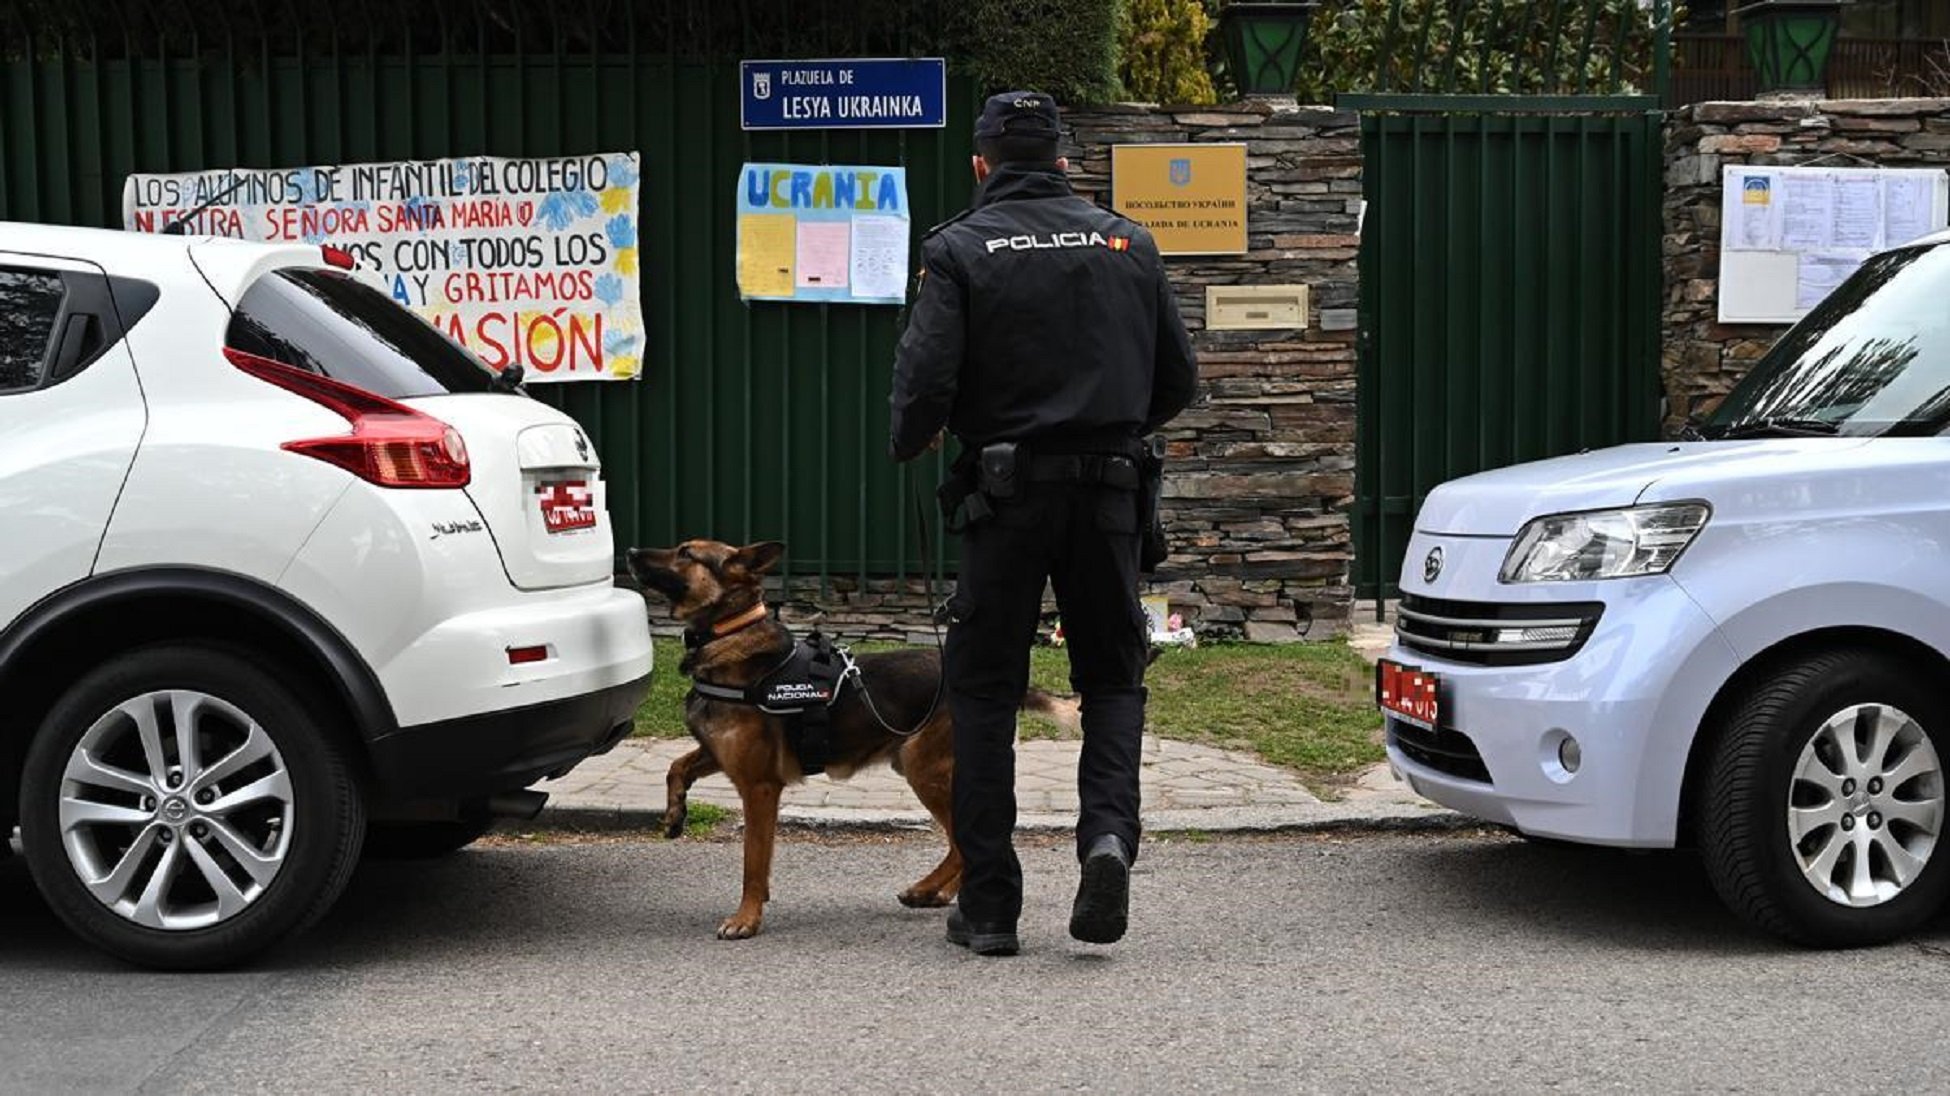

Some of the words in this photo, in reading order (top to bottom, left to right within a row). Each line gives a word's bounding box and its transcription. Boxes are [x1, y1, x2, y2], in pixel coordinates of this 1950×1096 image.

[781, 70, 834, 85] PLAZUELA
[839, 70, 854, 84] DE
[782, 96, 831, 119] LESYA
[838, 95, 923, 118] UKRAINKA
[134, 175, 180, 207] LOS
[194, 170, 303, 206] ALUMNOS
[314, 168, 342, 202] DE
[352, 162, 464, 201] INFANTIL
[503, 156, 609, 195] COLEGIO
[747, 169, 898, 210] UCRANIA
[265, 205, 369, 241] SEÑORA
[377, 201, 446, 233] SANTA
[451, 197, 513, 229] MARÍA
[394, 239, 450, 272] CON
[459, 236, 544, 269] TODOS
[555, 233, 607, 267] LOS
[985, 231, 1108, 253] POLICIA
[413, 274, 430, 306] Y
[444, 269, 594, 304] GRITAMOS
